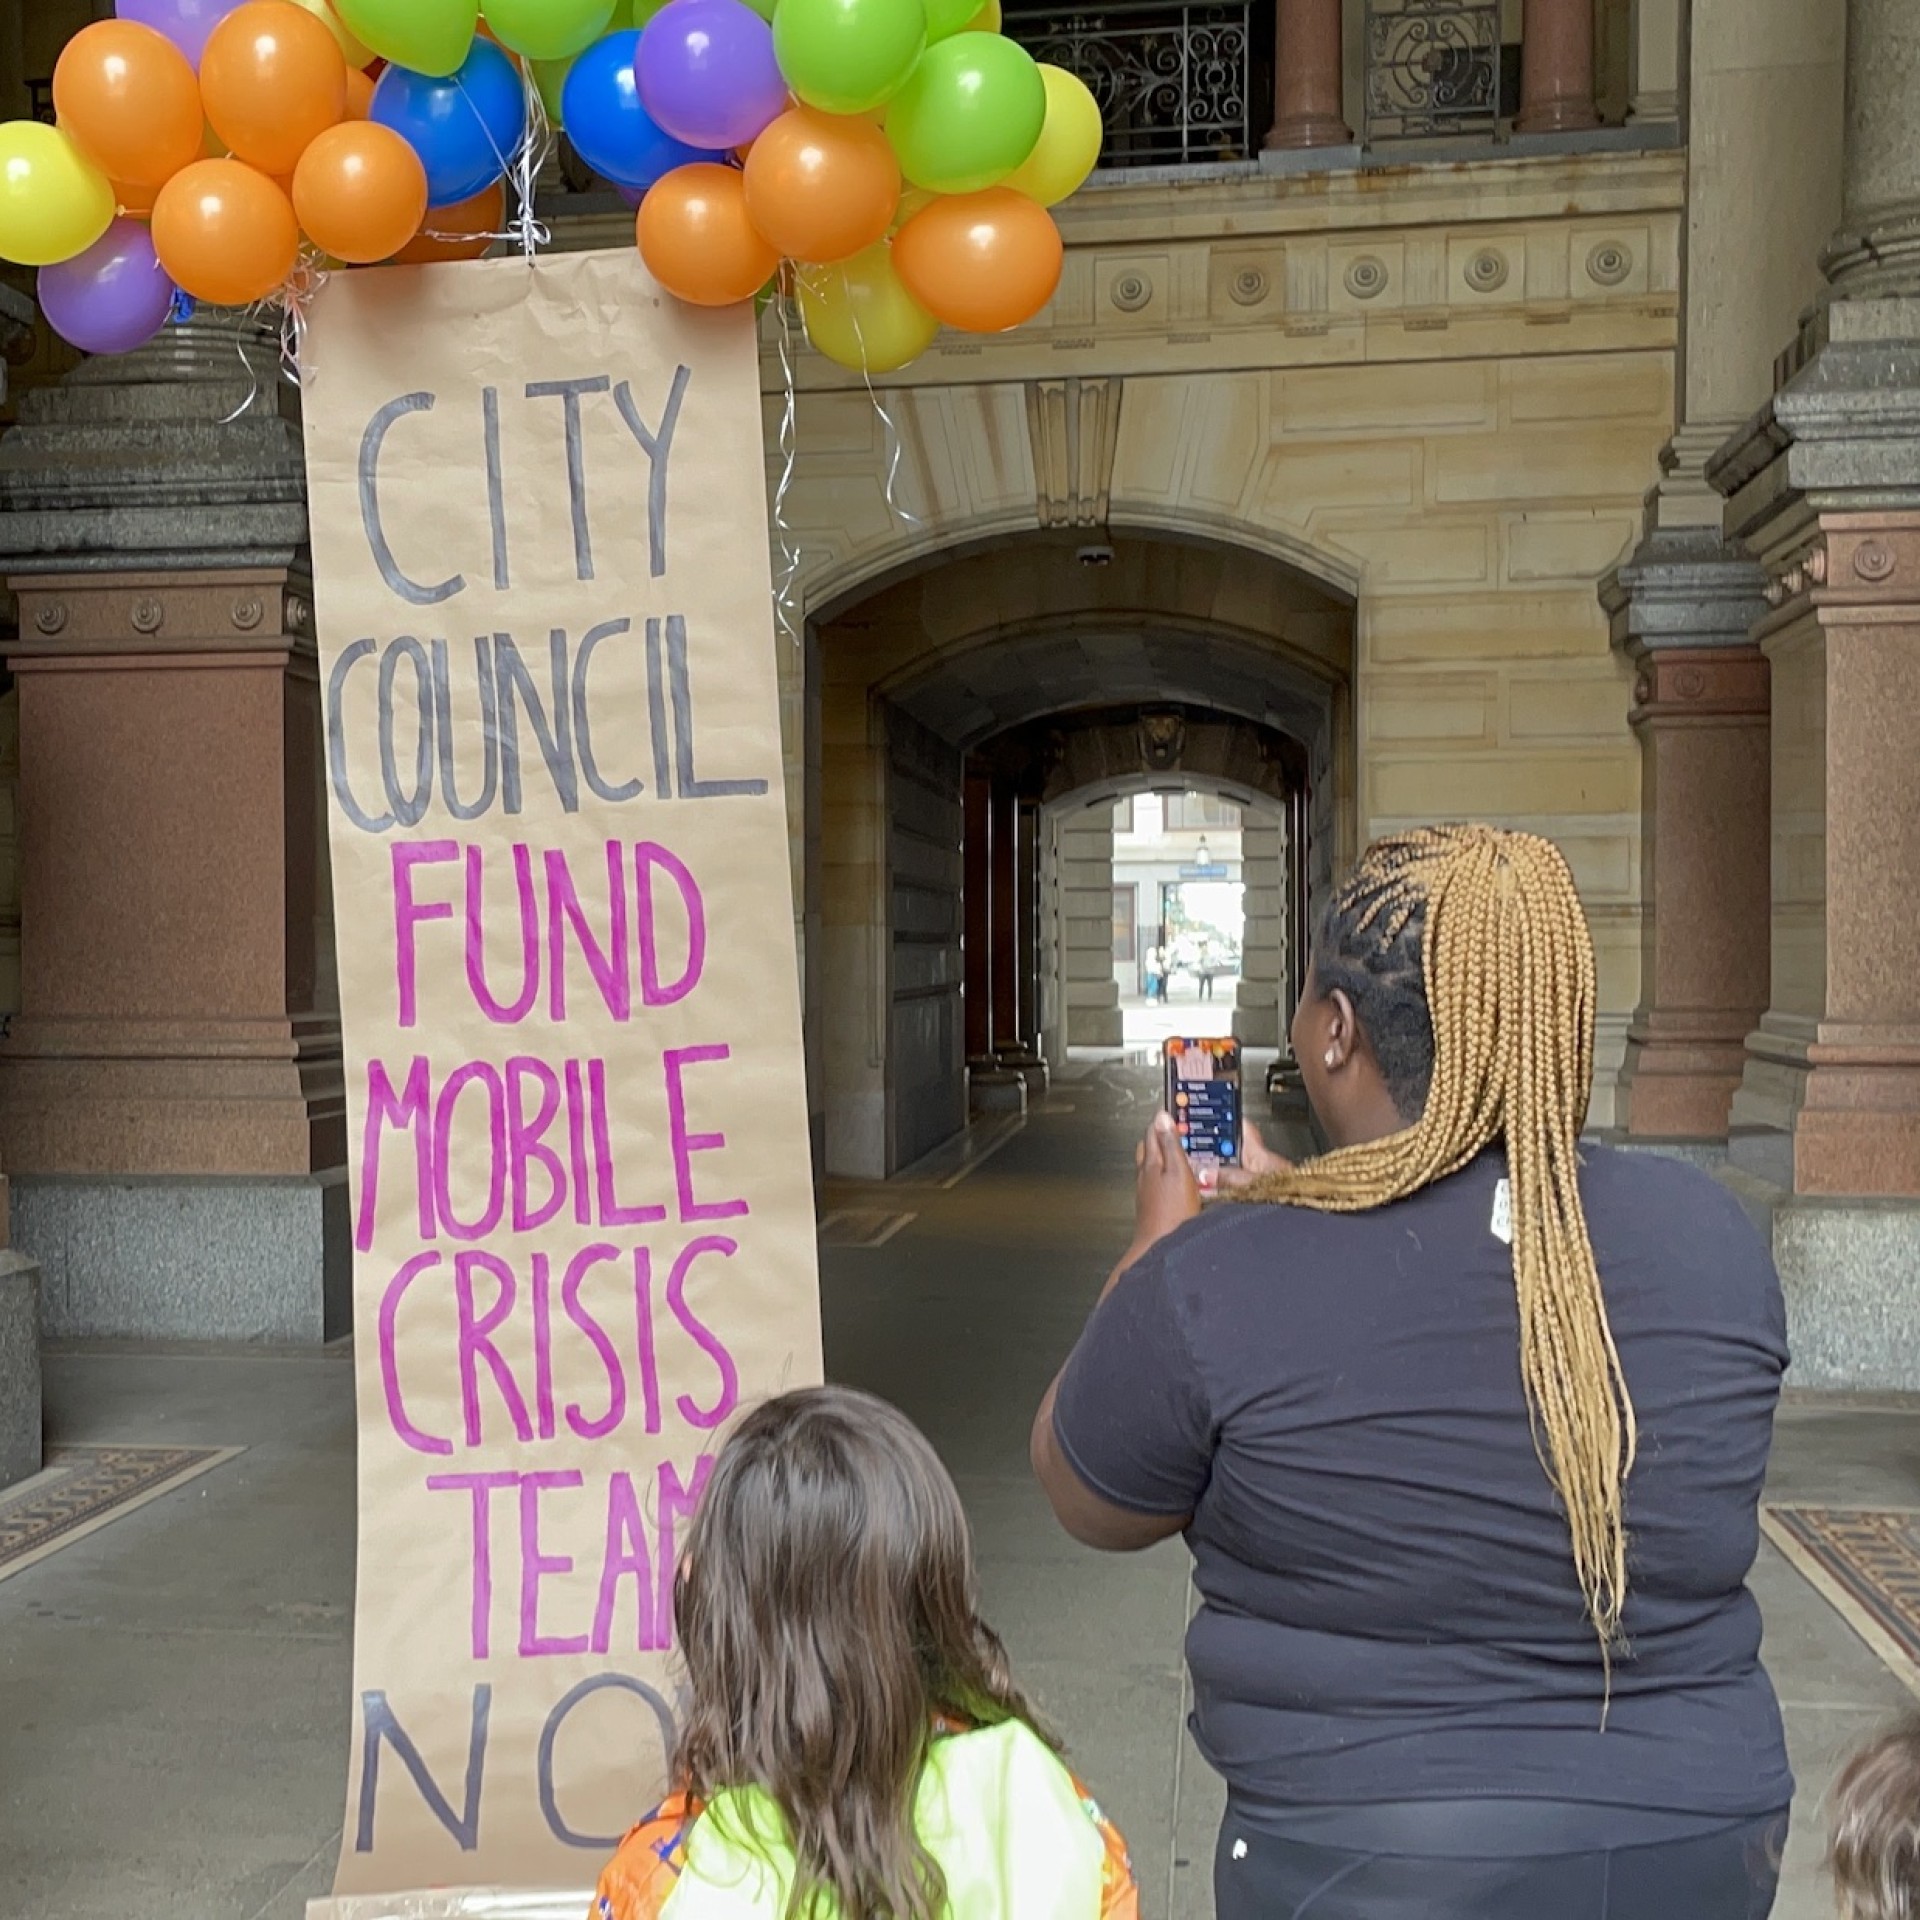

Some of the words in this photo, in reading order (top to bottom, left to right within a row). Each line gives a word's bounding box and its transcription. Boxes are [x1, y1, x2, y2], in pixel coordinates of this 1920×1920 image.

[357, 364, 692, 606] CITY
[328, 614, 769, 834] COUNCIL
[391, 839, 706, 1028] FUND
[355, 1042, 750, 1252] MOBILE
[378, 1235, 738, 1456] CRISIS
[355, 1672, 692, 1853] NO
